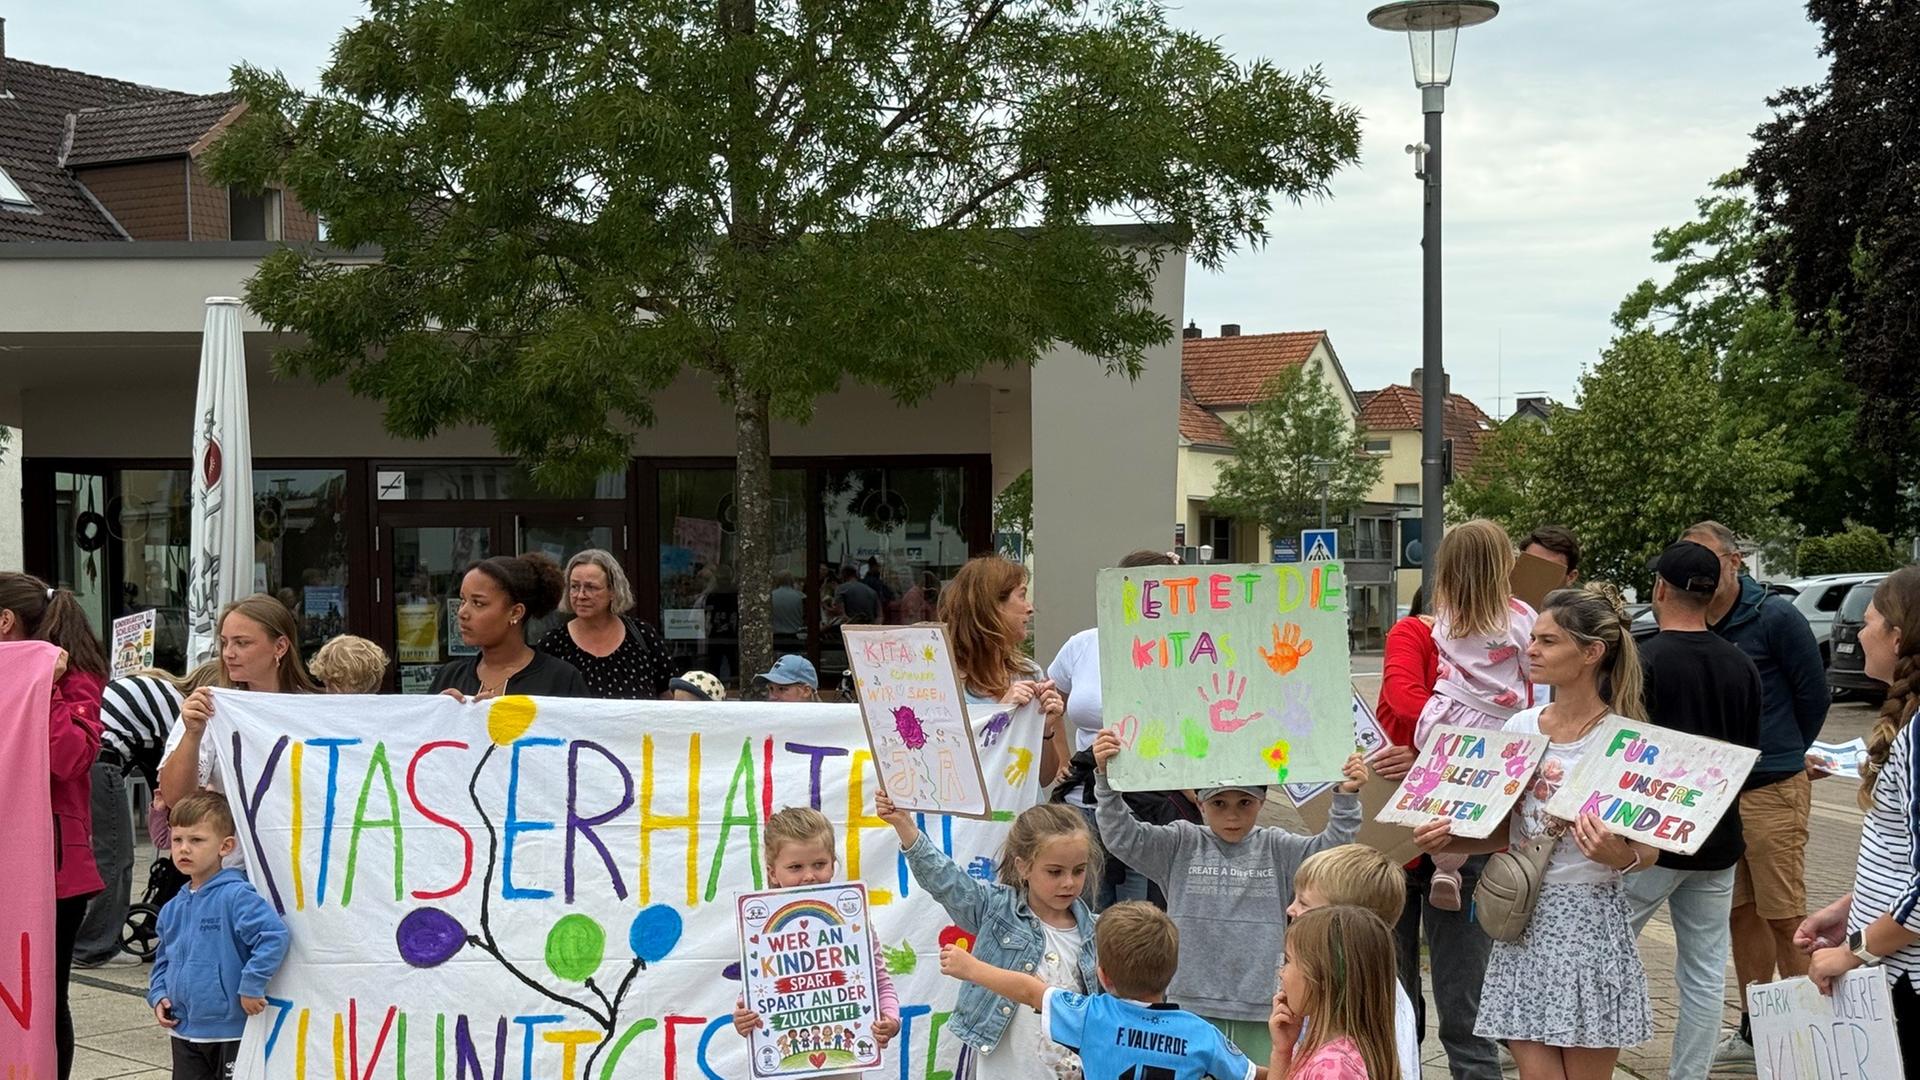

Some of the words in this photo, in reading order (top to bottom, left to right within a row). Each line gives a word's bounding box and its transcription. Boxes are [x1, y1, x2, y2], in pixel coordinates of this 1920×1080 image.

[1121, 573, 1262, 626] RETTET
[1271, 564, 1342, 613] DIE
[863, 640, 914, 665] KITA
[1131, 630, 1238, 671] KITAS
[867, 686, 897, 701] WIR
[1431, 732, 1486, 759] KITA
[1605, 728, 1660, 765] FÜR
[1440, 764, 1500, 789] BLEIBT
[1618, 770, 1704, 808] UNSERE
[1395, 792, 1487, 821] ERHALTEN
[1578, 790, 1696, 844] KINDER
[1187, 865, 1219, 876] CREATE
[1220, 867, 1229, 876] A
[767, 931, 811, 953] WER
[817, 926, 844, 946] AN
[760, 944, 861, 979] KINDERN
[789, 973, 836, 991] SPART.
[758, 993, 806, 1014] SPART
[812, 990, 833, 1007] AN
[837, 985, 867, 1002] DER
[1750, 987, 1792, 1018] STARK
[779, 1006, 855, 1029] ZUKUNFT!
[1127, 1028, 1189, 1057] VALVERDE
